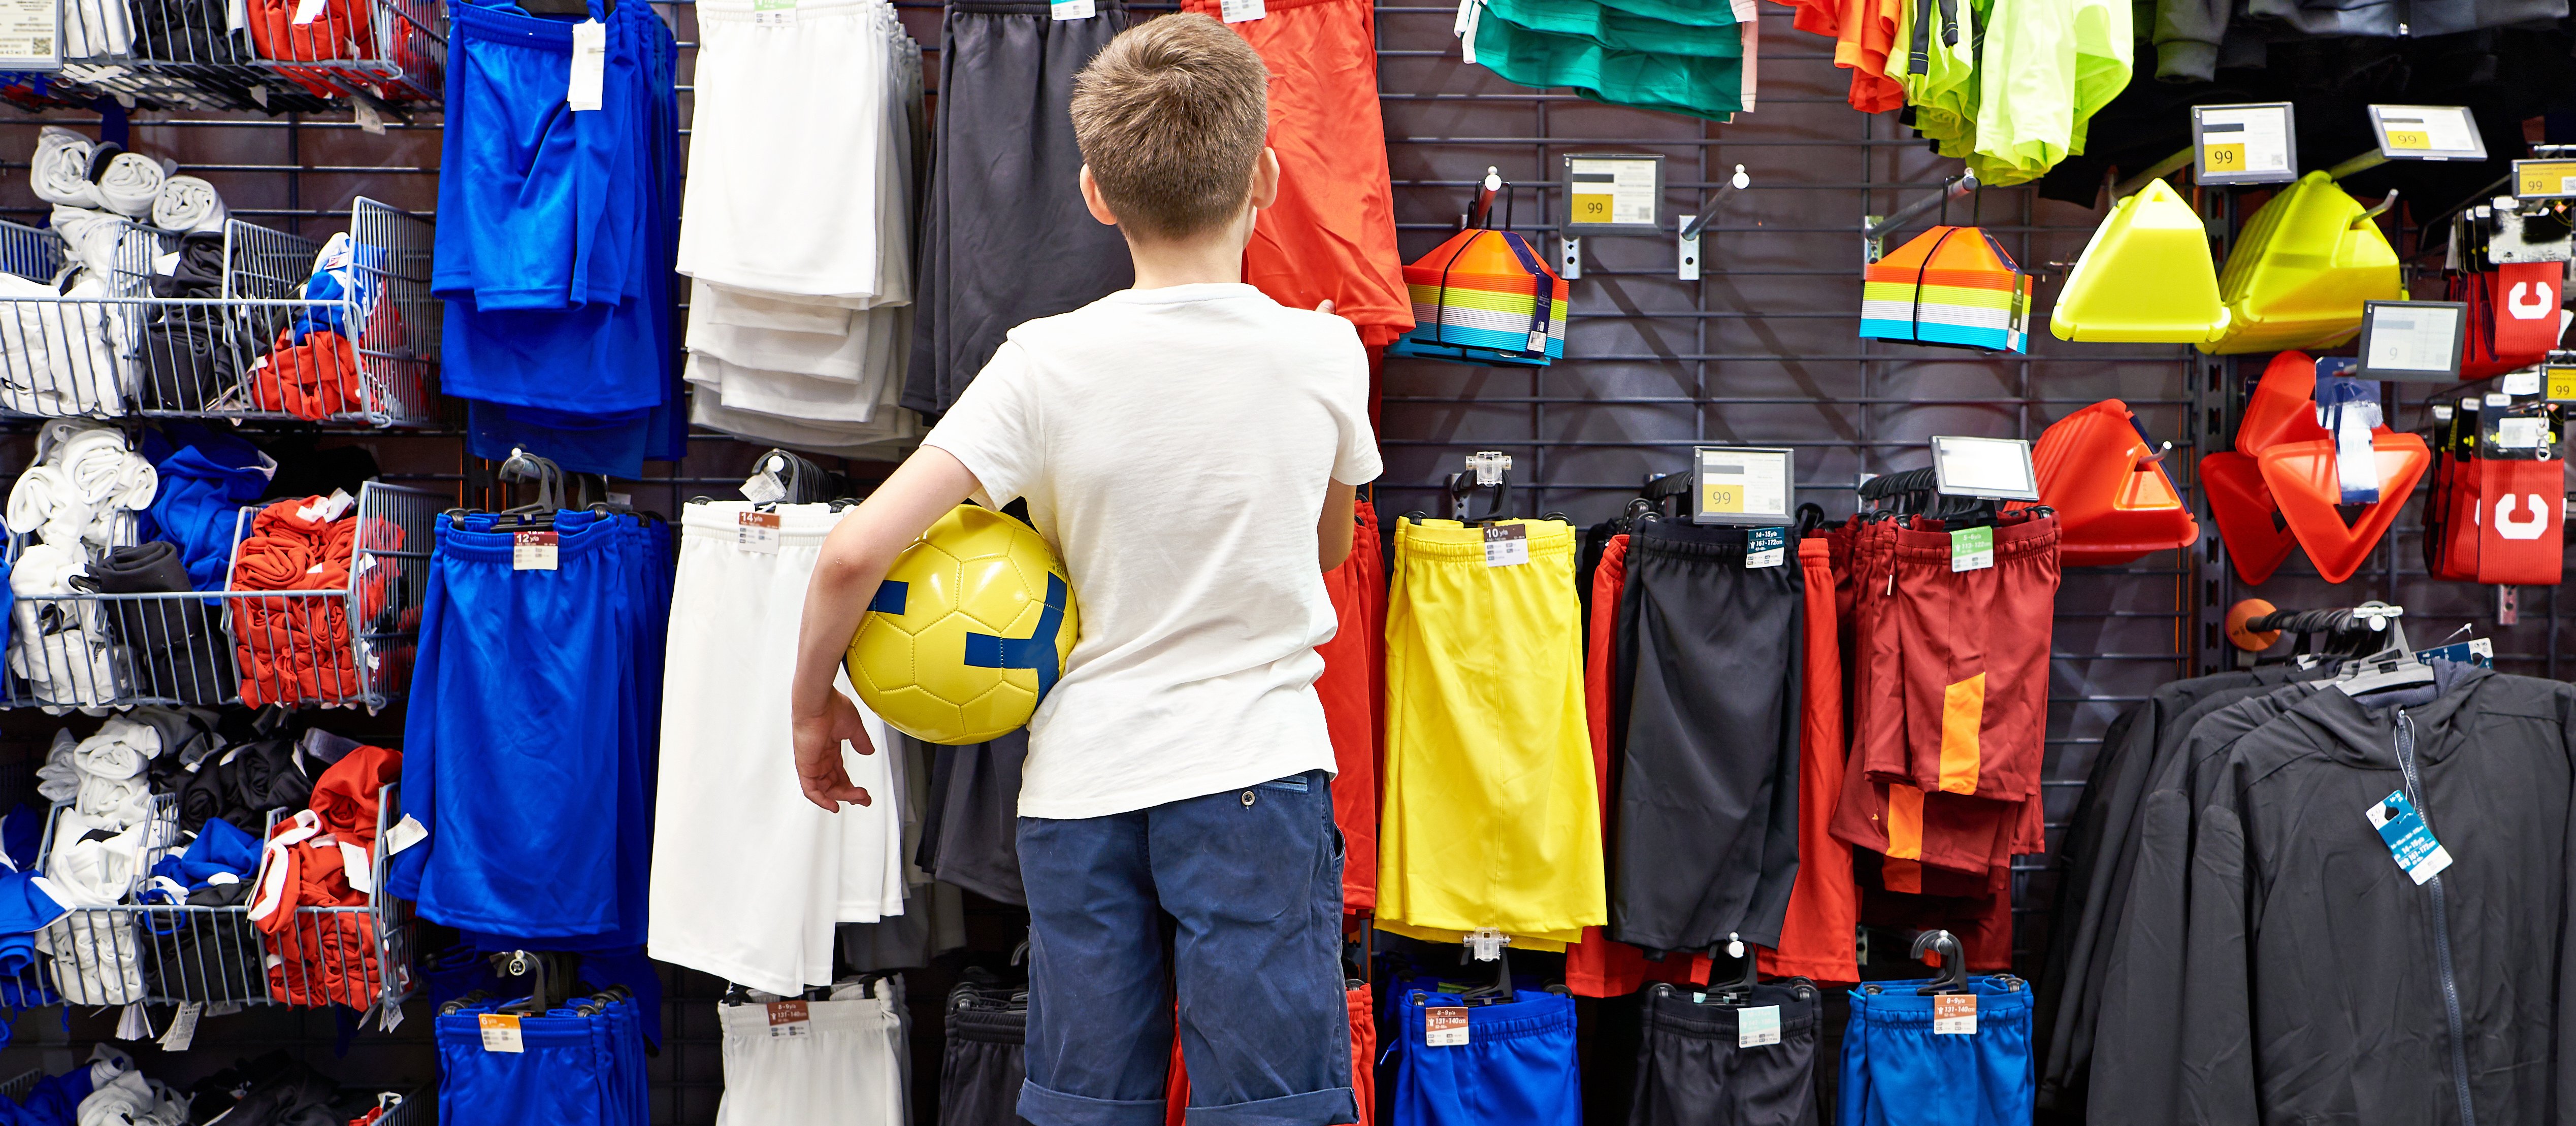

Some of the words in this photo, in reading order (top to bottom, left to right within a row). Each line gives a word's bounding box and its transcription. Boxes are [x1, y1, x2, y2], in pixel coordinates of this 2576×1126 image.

[2398, 135, 2417, 144] 99
[2214, 150, 2233, 164] 99
[2528, 180, 2542, 191] 99
[1588, 203, 1603, 214] 99
[2508, 282, 2553, 319] C
[2389, 347, 2398, 360] 9
[2556, 385, 2569, 395] 99
[1713, 491, 1731, 505] 99
[741, 512, 754, 522] 14
[2495, 493, 2549, 540] C
[516, 534, 529, 543] 12
[1486, 528, 1498, 538] 10
[1499, 529, 1509, 537] y/a
[481, 1017, 488, 1025] 6
